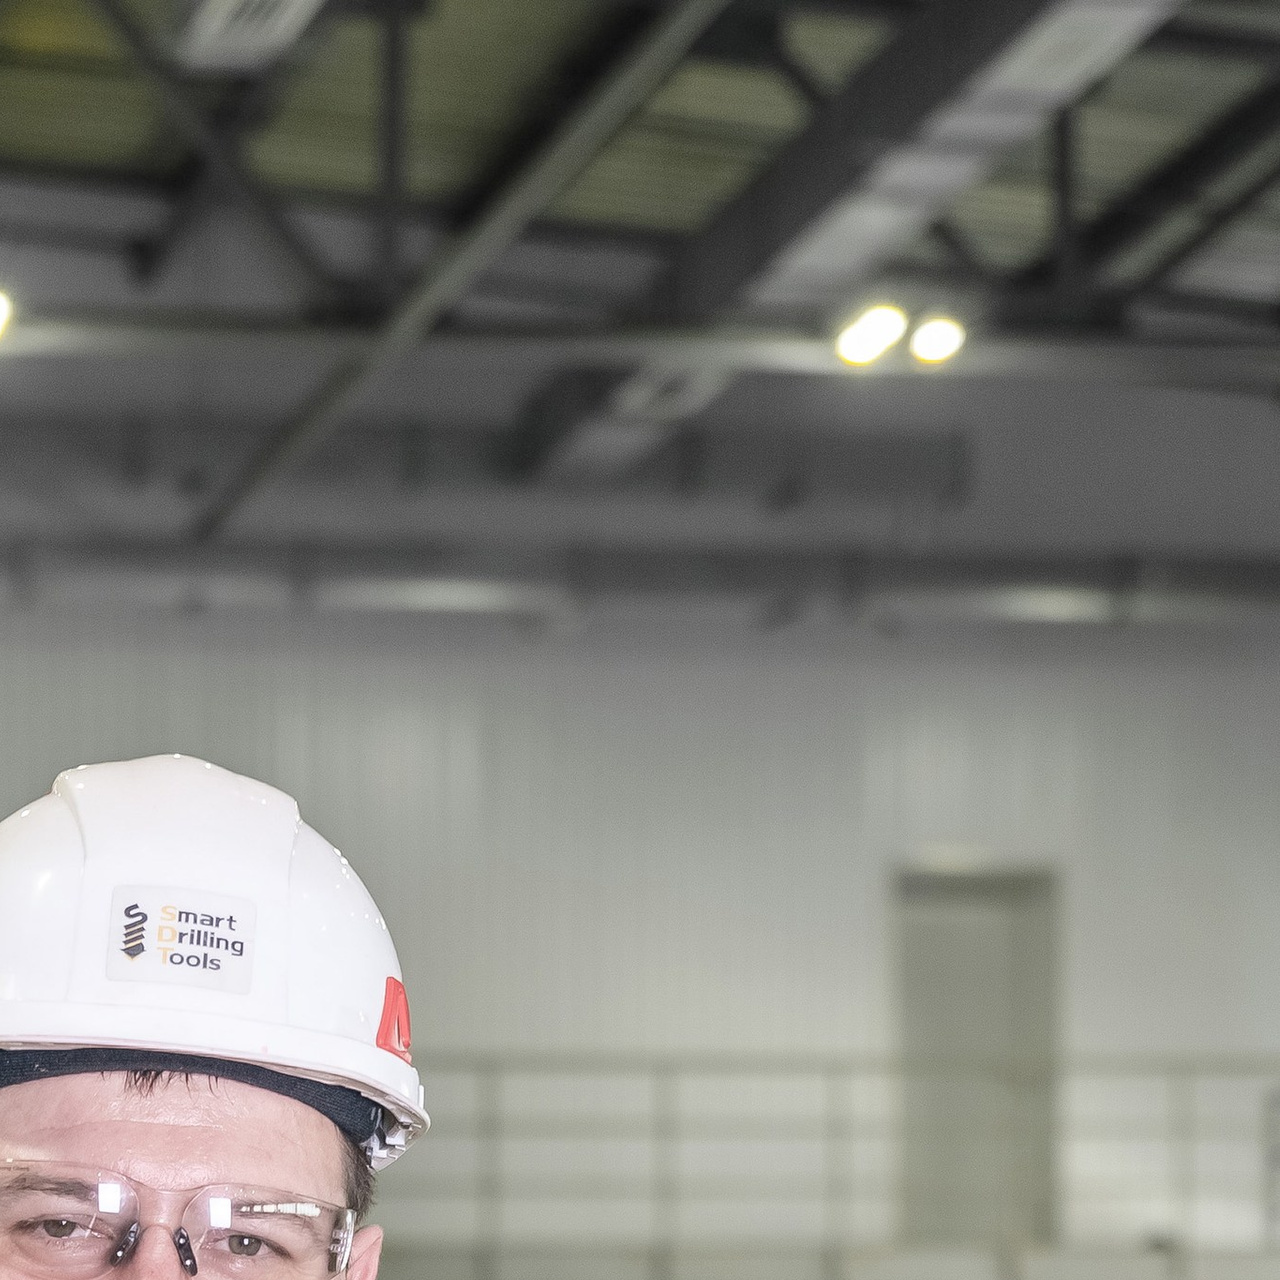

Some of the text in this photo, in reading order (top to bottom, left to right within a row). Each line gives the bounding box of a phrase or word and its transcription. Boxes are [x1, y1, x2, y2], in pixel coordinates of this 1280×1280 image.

[160, 905, 237, 931] Smart
[157, 925, 244, 956] Drilling
[156, 947, 221, 970] Tools
